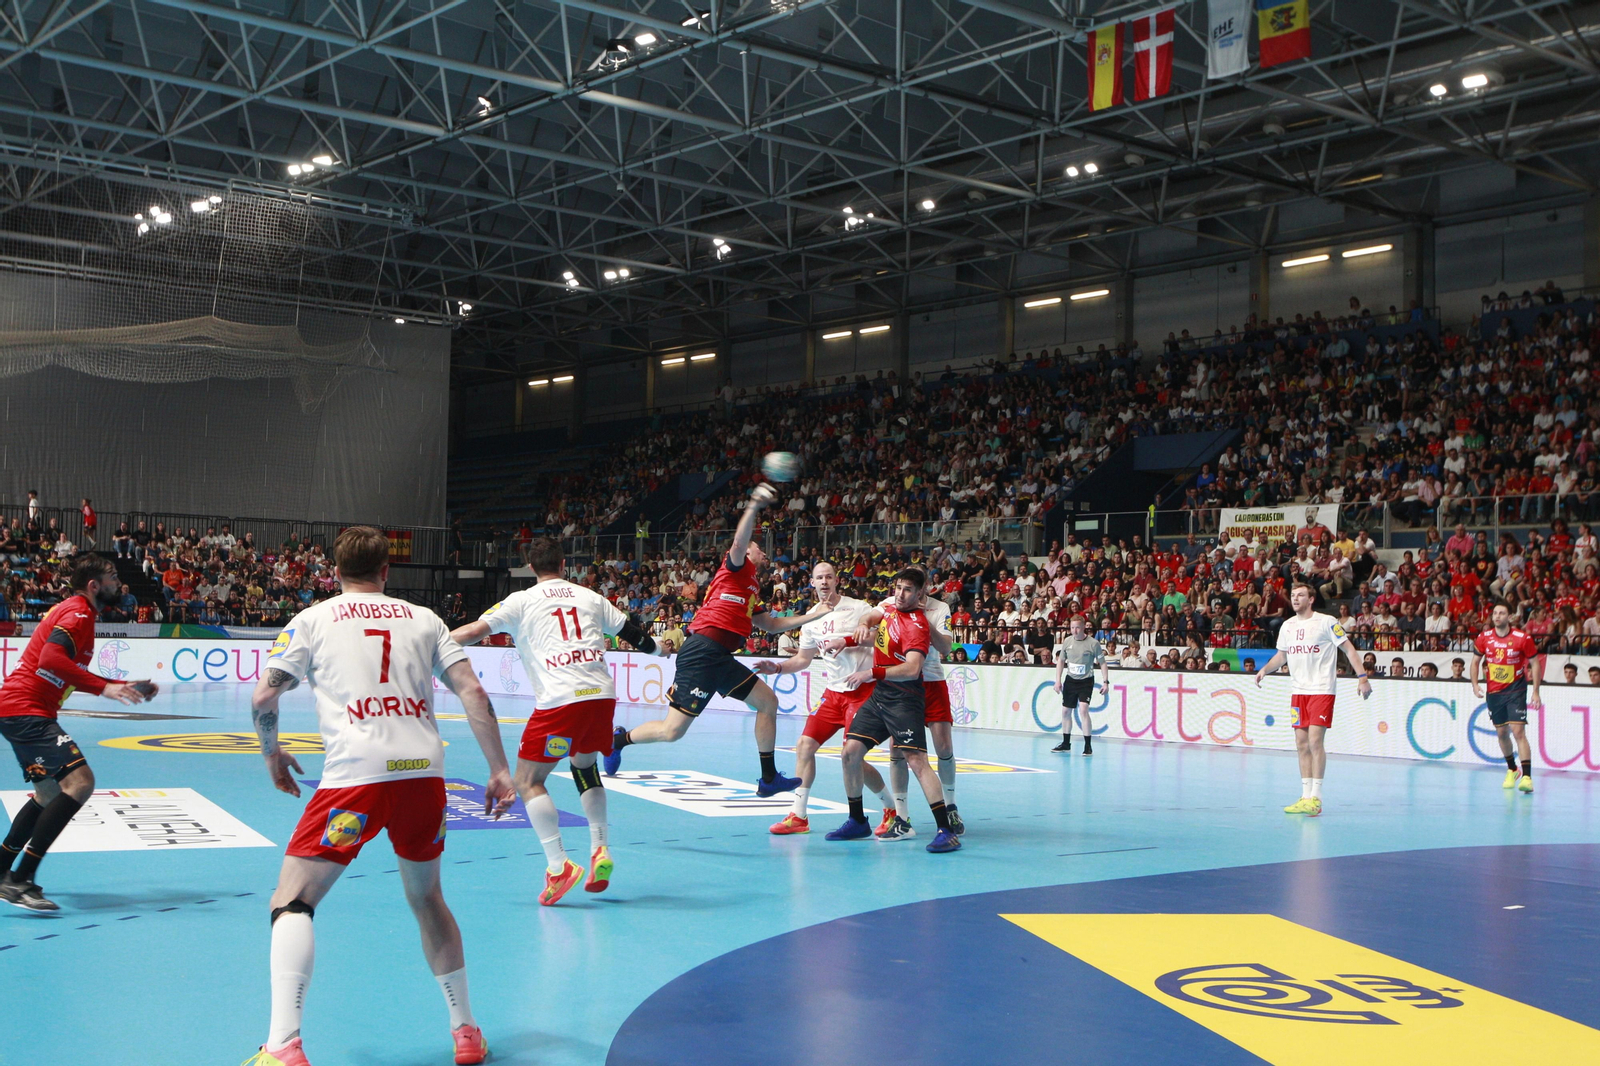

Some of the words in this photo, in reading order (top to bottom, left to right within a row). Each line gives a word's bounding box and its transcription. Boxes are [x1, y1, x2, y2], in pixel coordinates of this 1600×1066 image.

[1213, 17, 1234, 39] EHF
[1273, 512, 1285, 521] CON
[542, 587, 575, 598] LAUGE
[331, 602, 413, 622] JAKOBSEN
[551, 606, 582, 641] 11
[822, 620, 835, 635] 34
[1295, 628, 1305, 641] 19
[364, 629, 391, 684] 7
[546, 649, 604, 671] NORLYS
[574, 687, 602, 697] BORUP
[347, 696, 430, 725] NORLYS
[386, 758, 431, 771] BORUP
